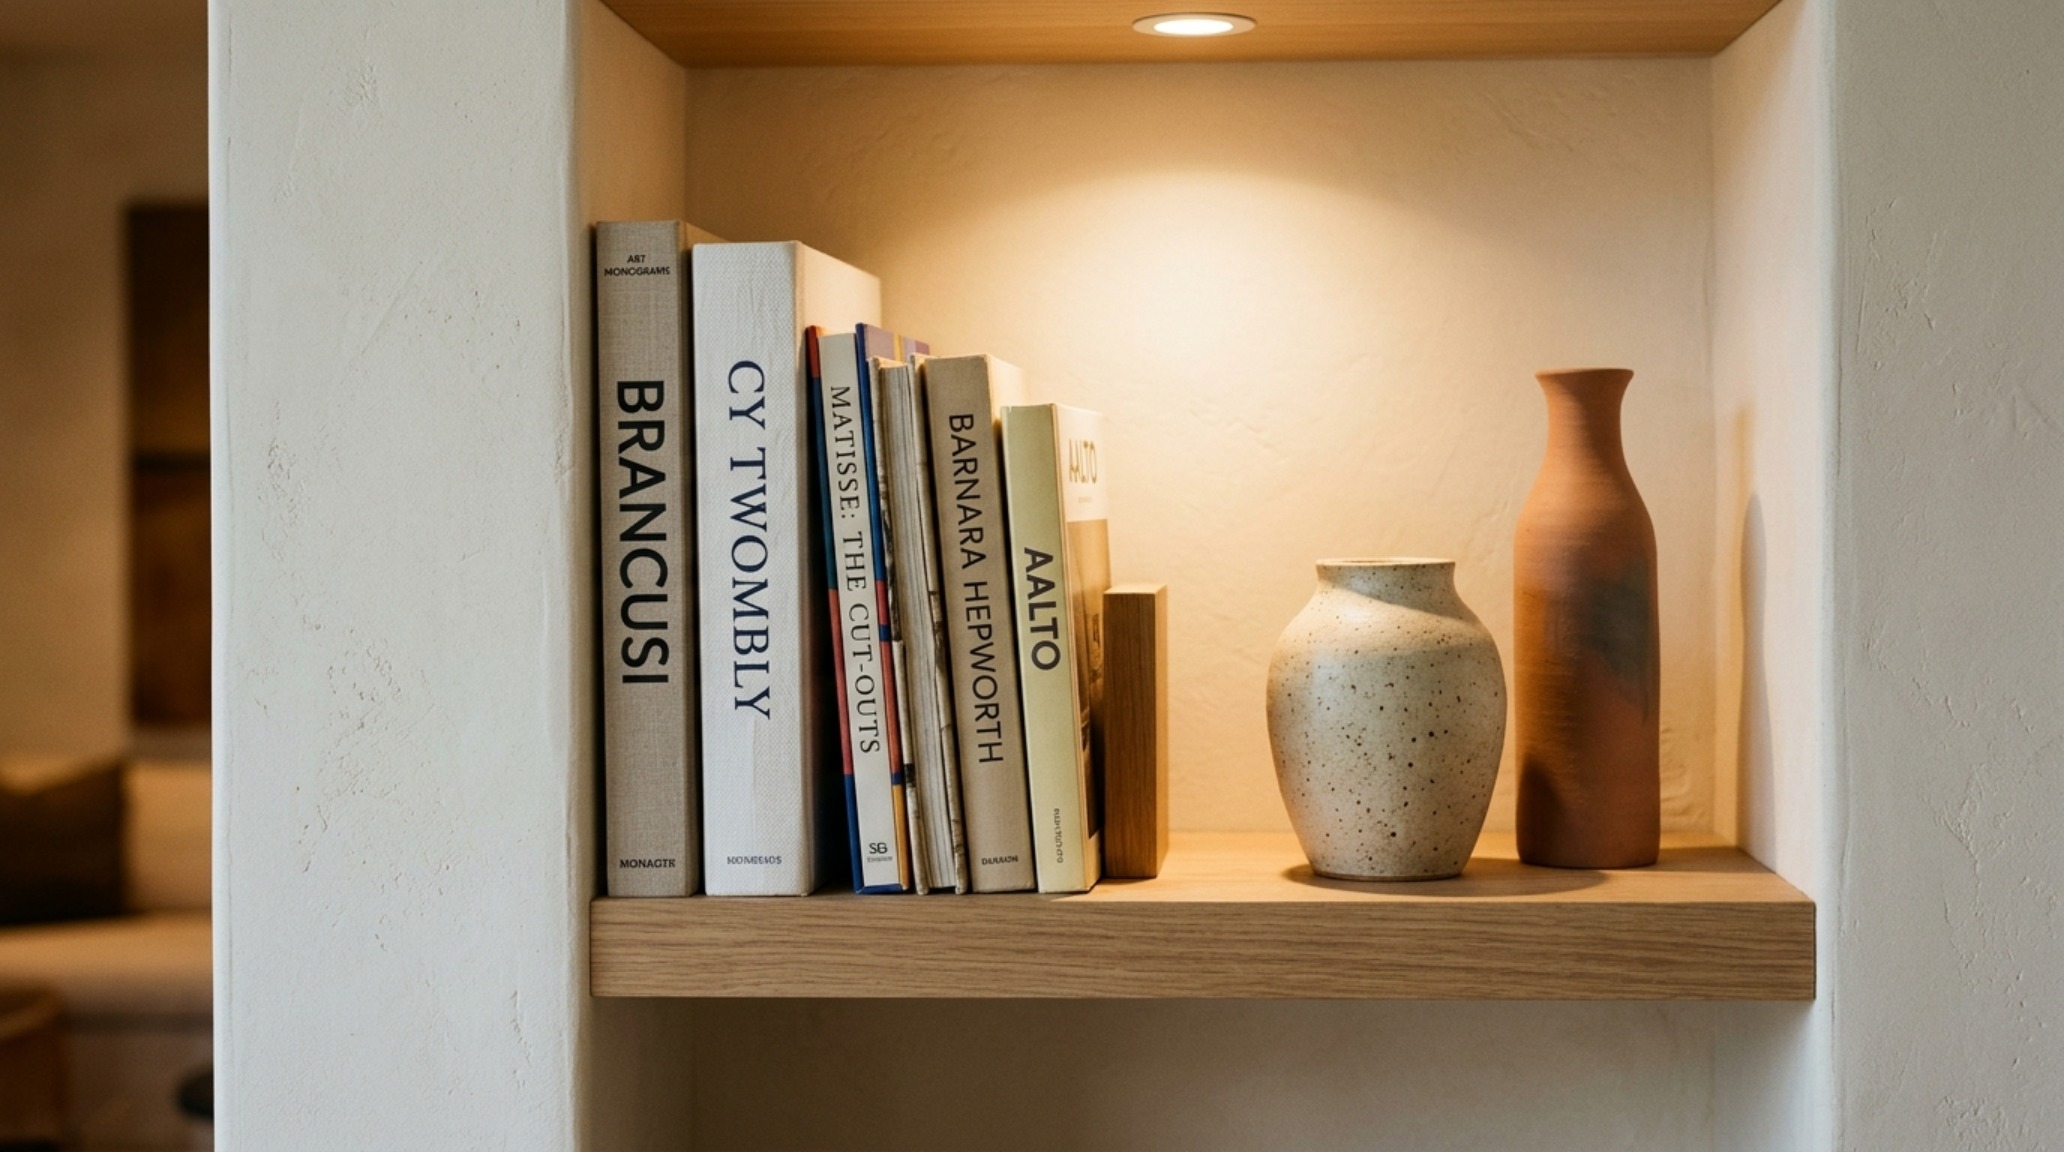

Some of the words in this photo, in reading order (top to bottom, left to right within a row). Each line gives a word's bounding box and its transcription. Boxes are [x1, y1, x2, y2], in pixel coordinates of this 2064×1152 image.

[727, 360, 766, 430] CY
[830, 385, 860, 519] MATISSE:
[616, 380, 670, 684] BRANCUSI
[843, 531, 867, 591] THE
[948, 413, 987, 570] BARNARA
[729, 447, 771, 720] TWOMBLY
[1024, 547, 1061, 671] AALTO
[848, 603, 881, 754] CUT-OUTS
[963, 581, 1004, 763] HEPWORTH
